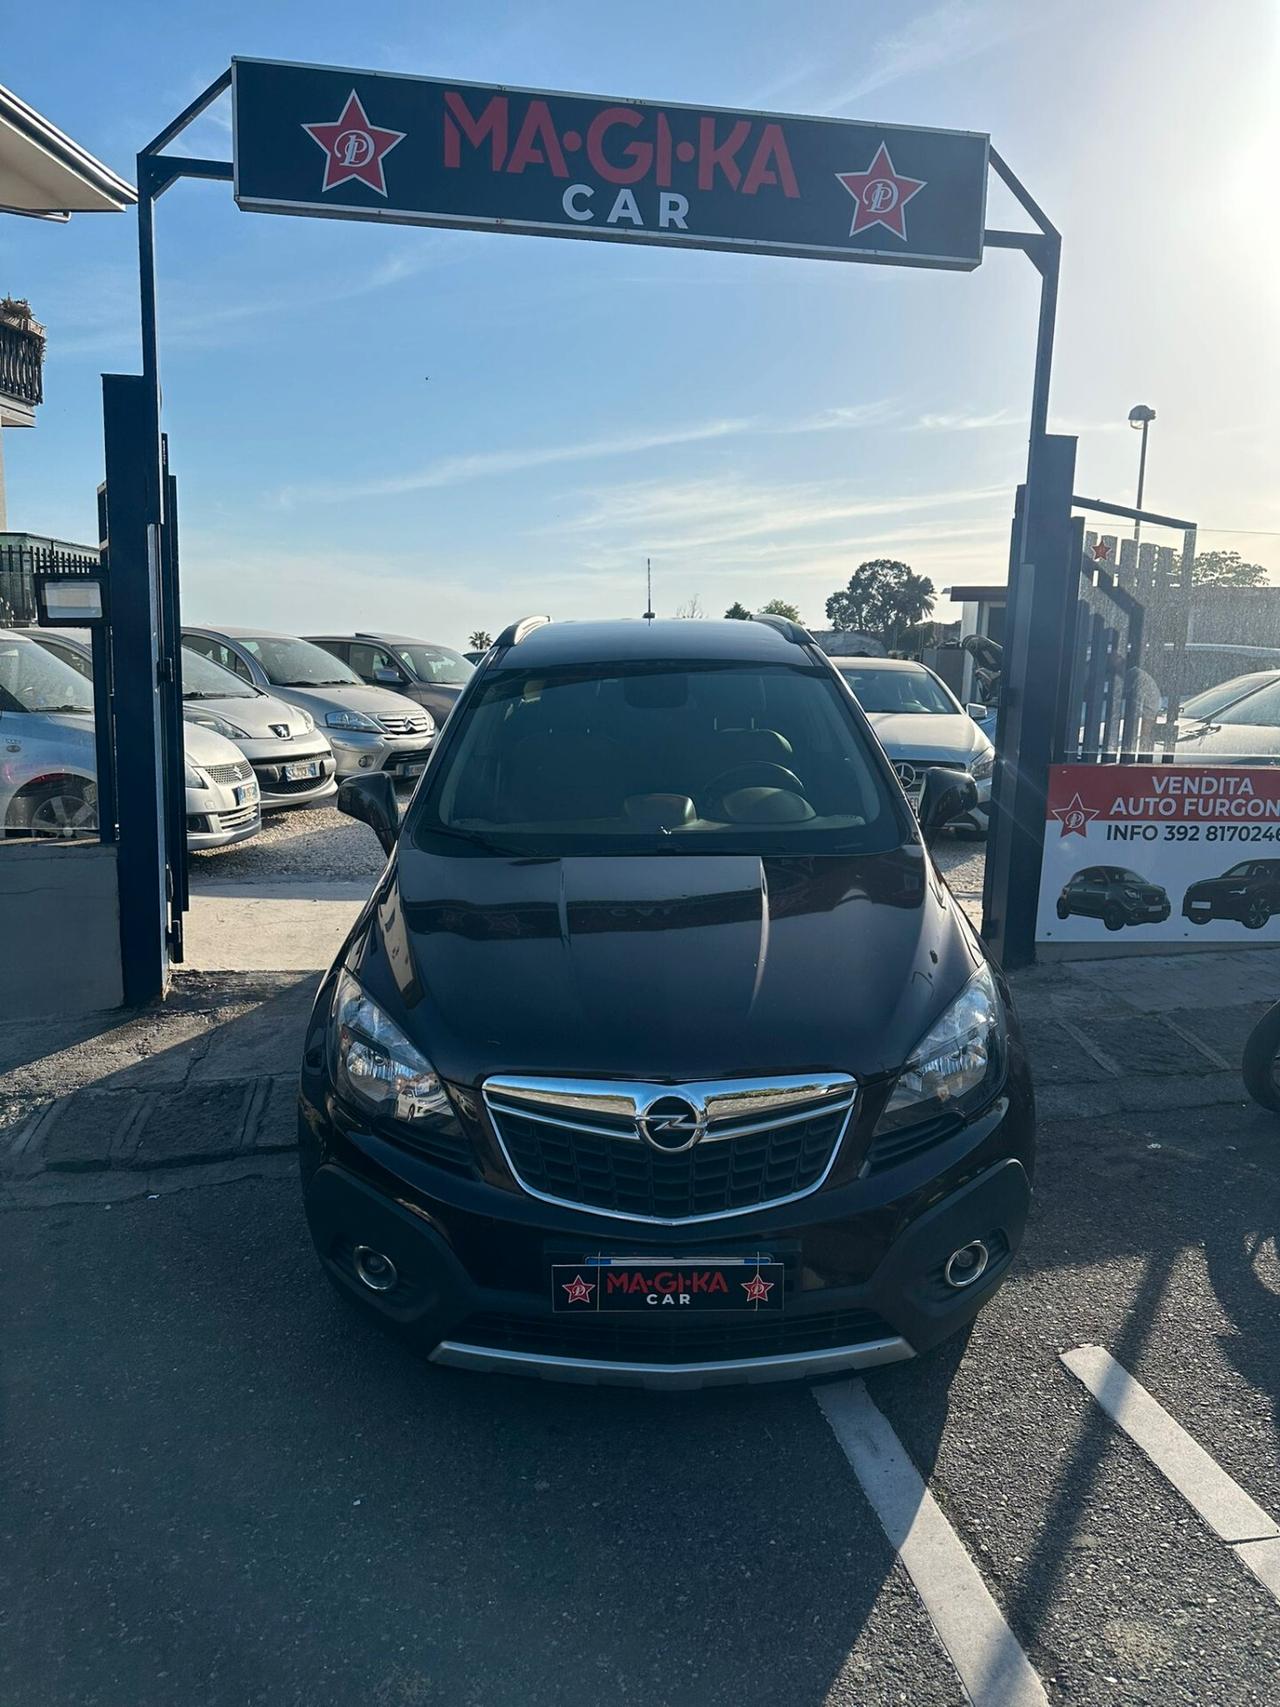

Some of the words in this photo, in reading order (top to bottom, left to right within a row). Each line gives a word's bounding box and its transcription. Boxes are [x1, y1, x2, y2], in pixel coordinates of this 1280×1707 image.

[562, 183, 690, 229] CAR
[1151, 775, 1255, 795] VENDITA
[1109, 796, 1177, 817] AUTO
[1106, 824, 1159, 841] INFO
[1163, 825, 1200, 842] 392
[646, 1293, 691, 1305] CAR
